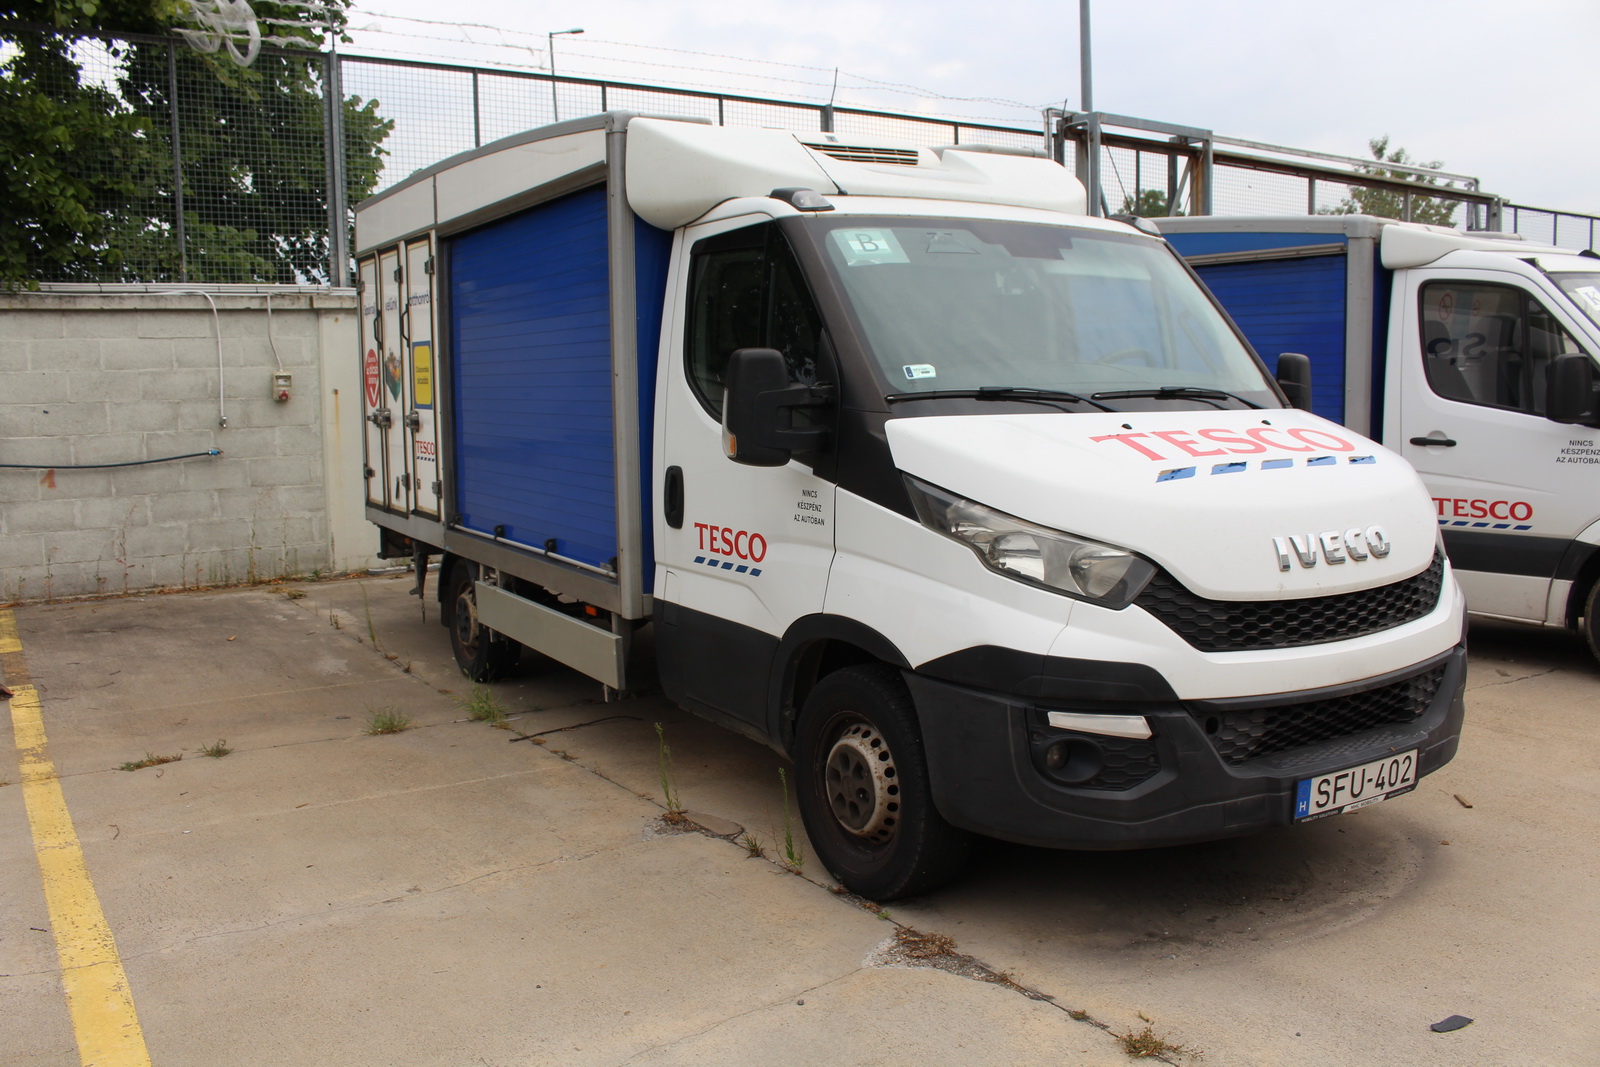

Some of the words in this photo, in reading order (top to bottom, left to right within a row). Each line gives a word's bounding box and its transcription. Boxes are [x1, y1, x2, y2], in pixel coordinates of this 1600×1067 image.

[855, 233, 880, 251] B
[415, 440, 435, 456] TESCO
[1088, 427, 1355, 461] TESCO
[1560, 447, 1600, 455] KÉSZPÉNZ
[1567, 456, 1600, 464] AUTÓBA
[802, 489, 818, 498] NINCS
[797, 499, 822, 512] KÉSZPÉNZ
[1431, 497, 1533, 521] TESCO
[793, 514, 801, 522] AZ
[801, 515, 825, 526] AUTÓBAN
[694, 522, 767, 563] TESCO
[1272, 525, 1391, 572] IVECO
[1315, 755, 1412, 808] SFU-402
[1299, 801, 1307, 812] H
[1361, 797, 1379, 806] MOBILITY
[1301, 815, 1319, 823] MOBILITY
[1319, 809, 1339, 819] SOLUTIONS
